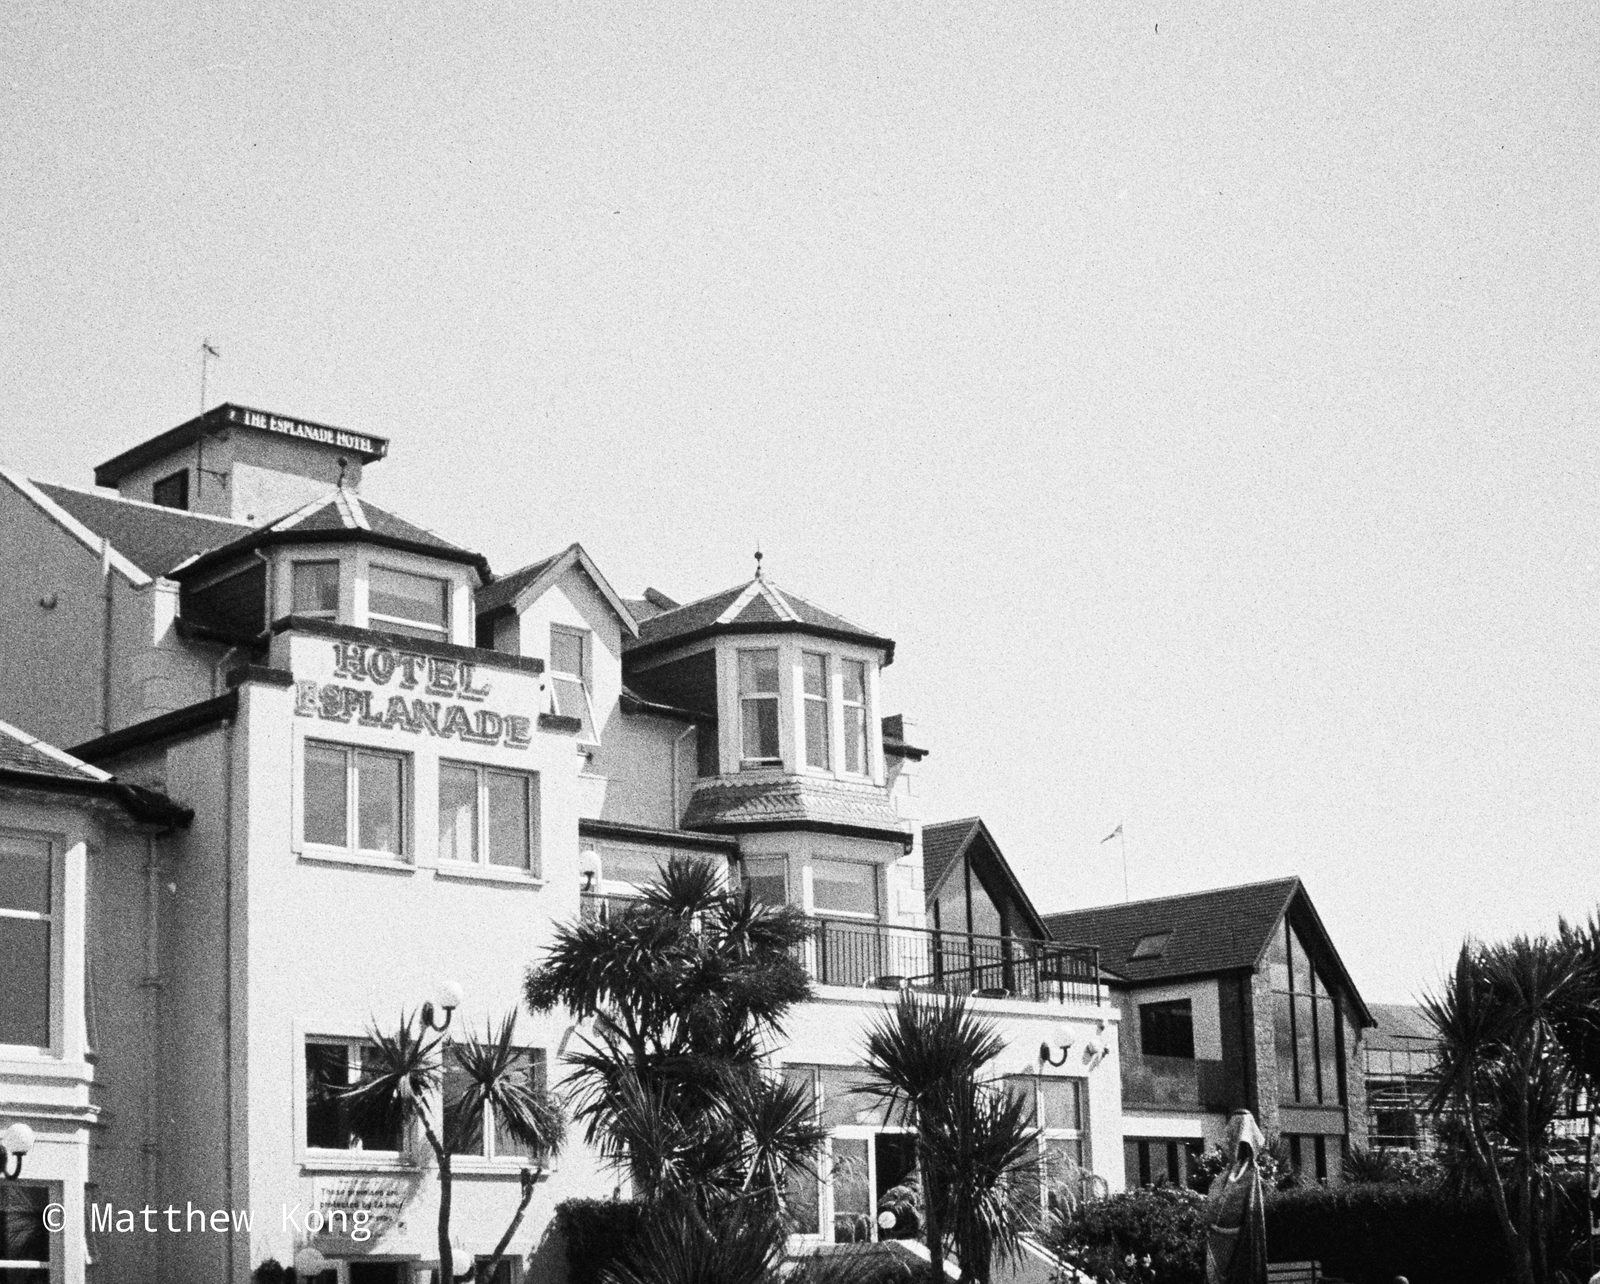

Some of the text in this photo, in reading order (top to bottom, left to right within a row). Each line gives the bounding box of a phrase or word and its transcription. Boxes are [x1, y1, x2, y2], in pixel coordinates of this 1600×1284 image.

[244, 411, 373, 452] THE ESPLANADE HOTEL
[332, 643, 492, 702] HOTEL
[294, 679, 532, 750] ESPLANADE
